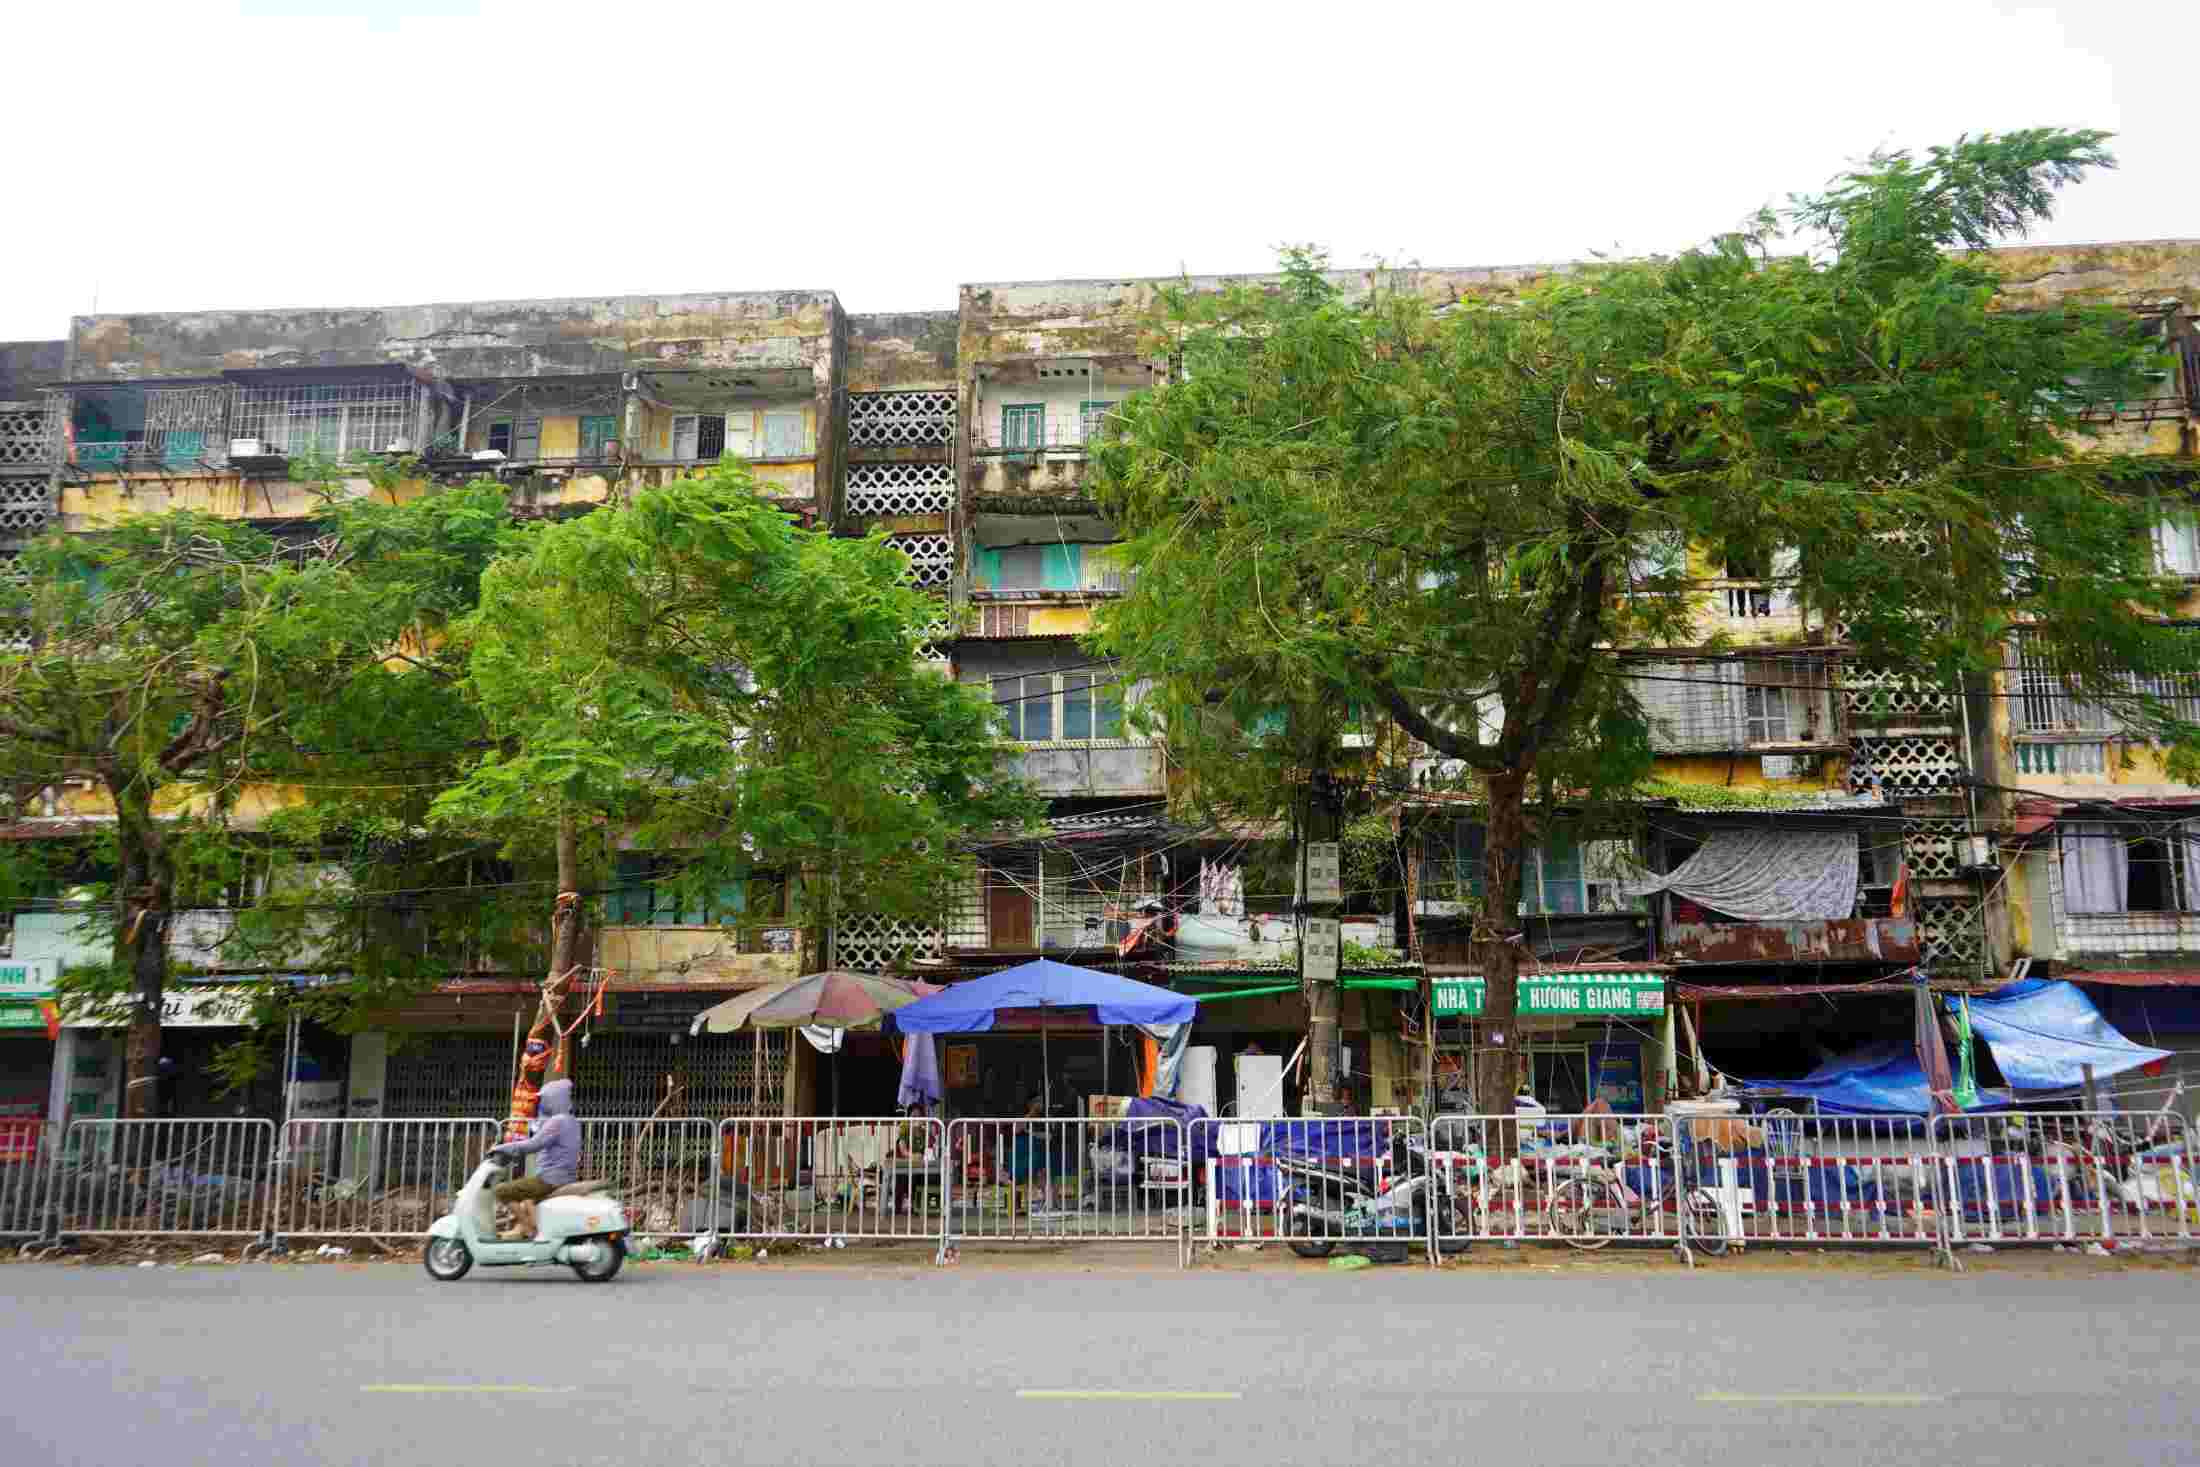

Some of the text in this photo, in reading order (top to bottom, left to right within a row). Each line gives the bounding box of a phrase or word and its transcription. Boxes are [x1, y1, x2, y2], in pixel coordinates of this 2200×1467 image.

[1437, 983, 1468, 1009] NHÀ
[1529, 985, 1580, 1009] HƯƠNG
[1586, 986, 1632, 1009] GIANG
